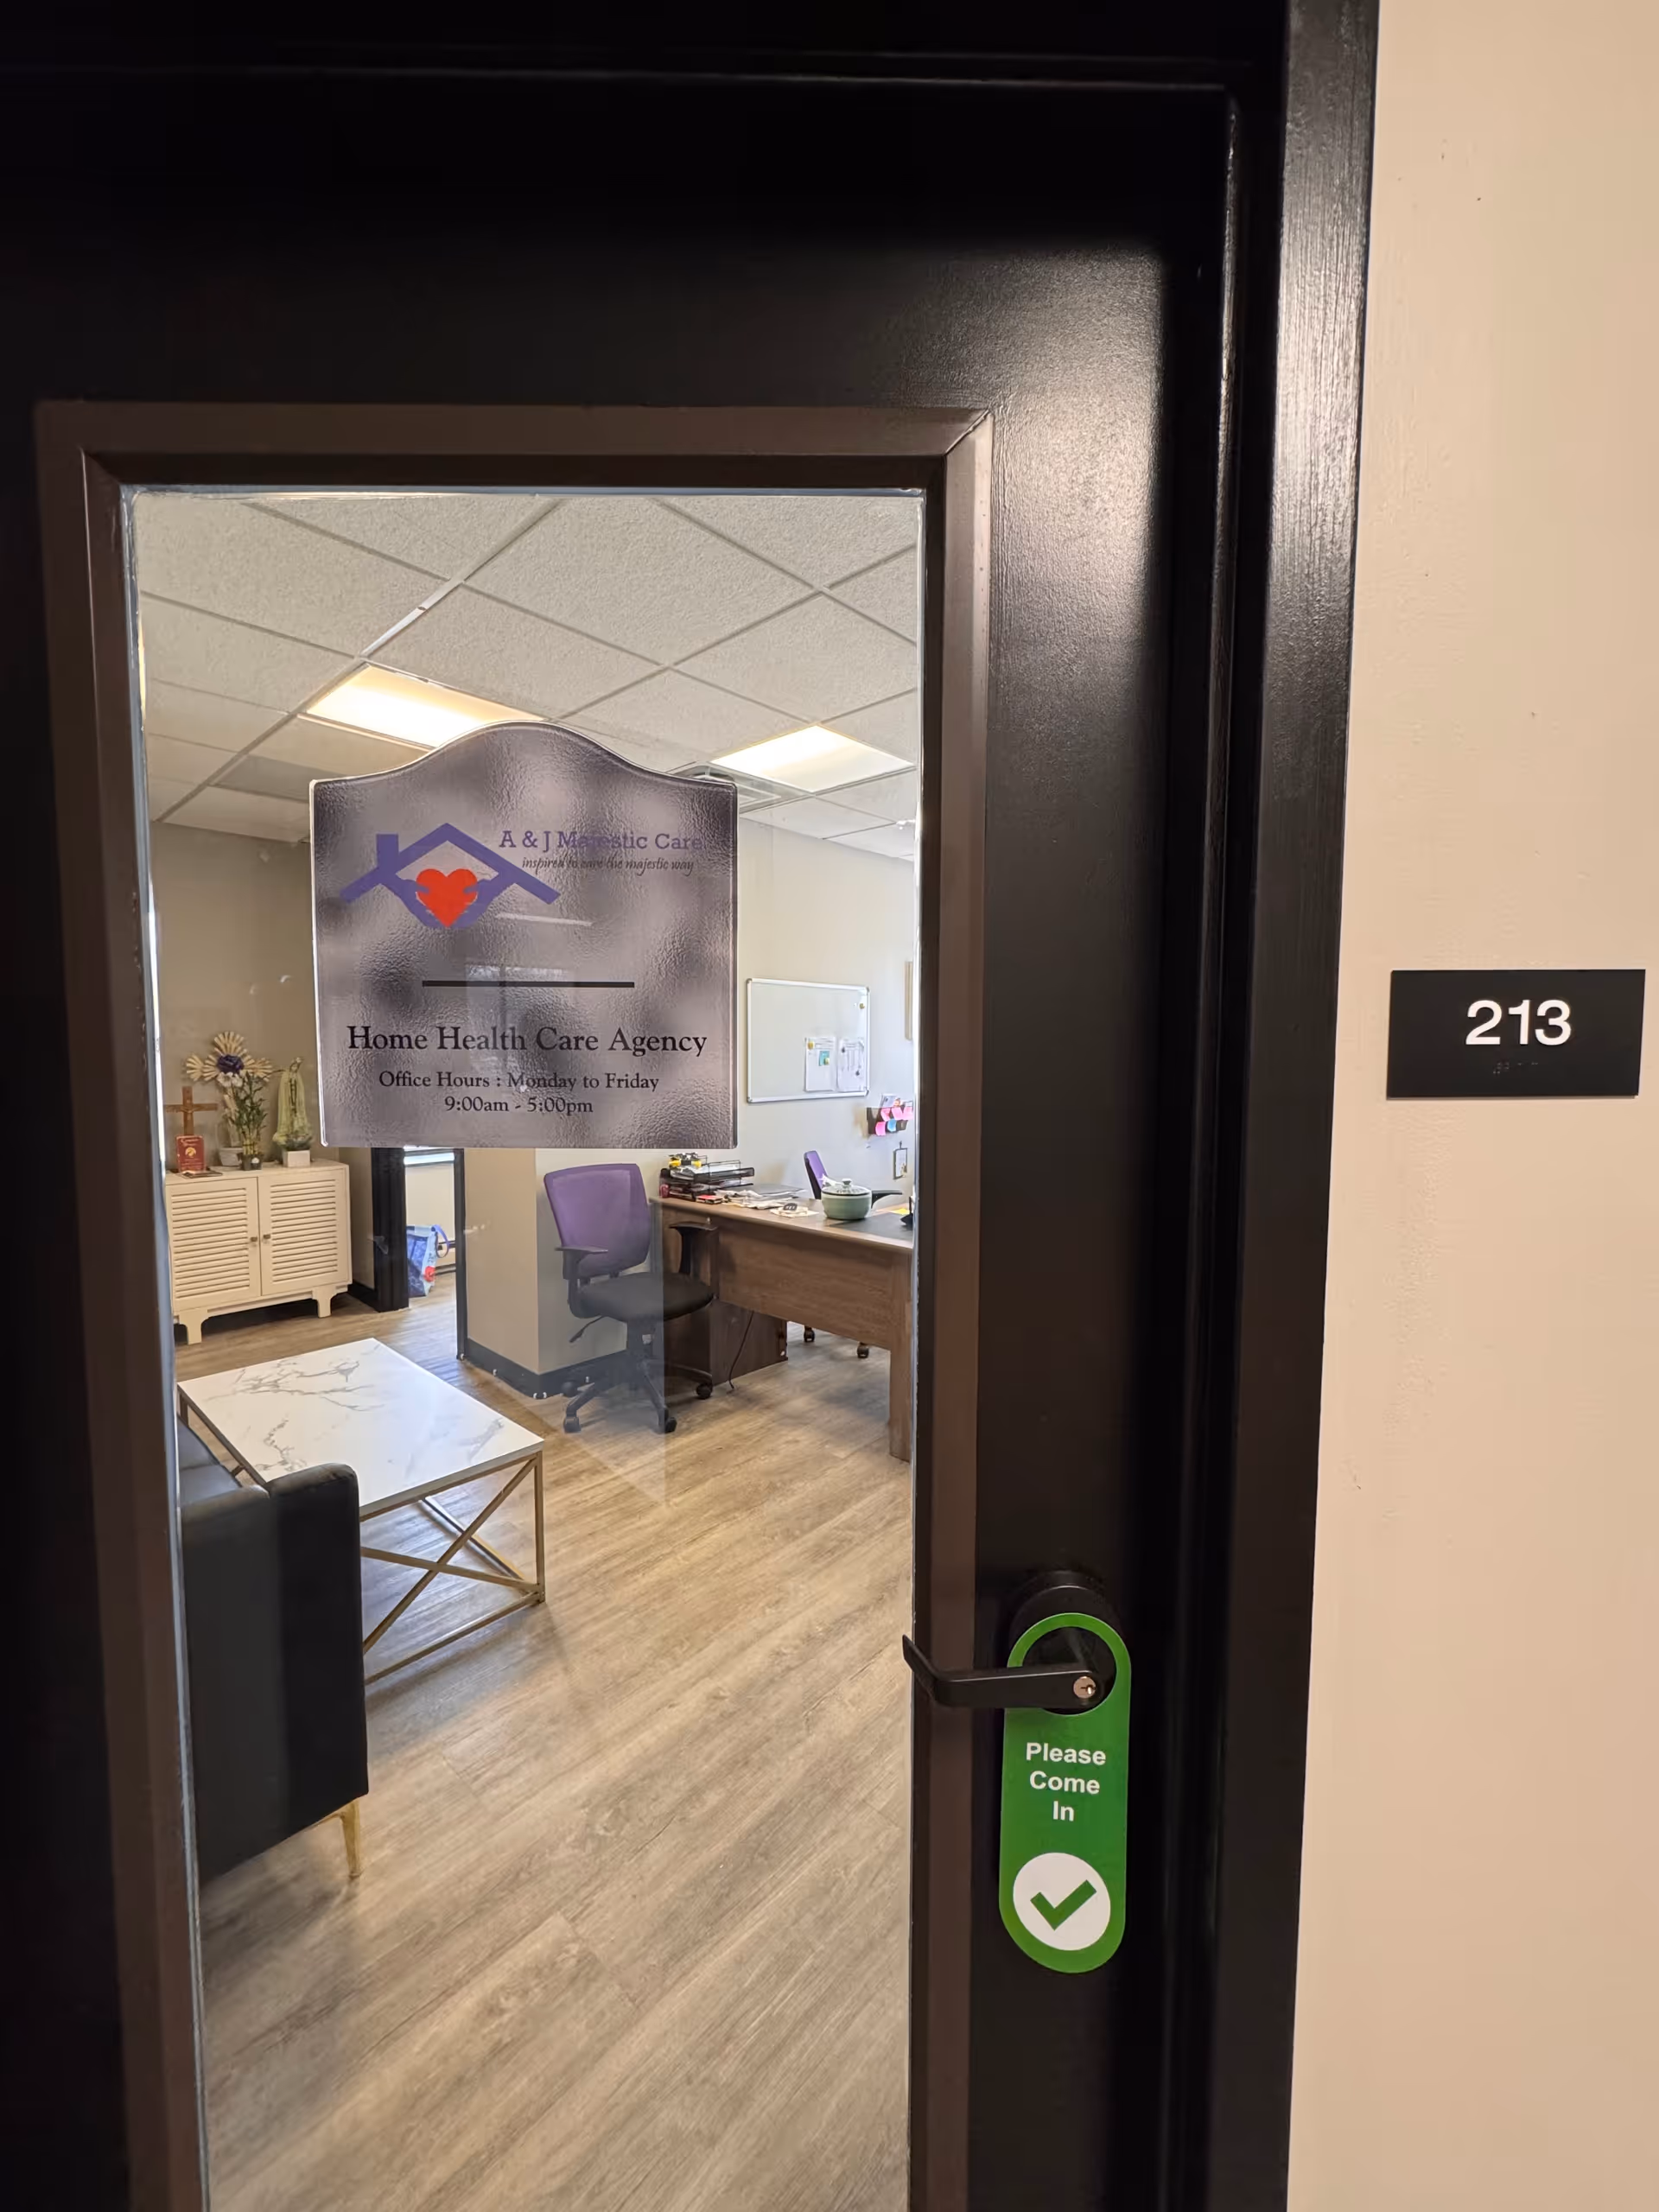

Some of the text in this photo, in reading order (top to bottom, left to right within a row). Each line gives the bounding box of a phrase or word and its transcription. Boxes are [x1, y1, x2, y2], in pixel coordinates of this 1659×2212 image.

[499, 830, 516, 849] A
[522, 830, 538, 849] &
[543, 830, 550, 853] J
[654, 833, 703, 850] Care
[625, 857, 669, 876] majestic
[671, 861, 694, 877] way
[1465, 999, 1572, 1046] 213
[346, 1025, 708, 1058] Home Health Care Agency
[378, 1070, 432, 1088] Office
[435, 1071, 490, 1088] Hours
[507, 1072, 577, 1092] Monday
[583, 1076, 600, 1089] to
[604, 1072, 659, 1092] Friday
[444, 1096, 510, 1112] 9:00am
[527, 1096, 594, 1116] 5:00pm
[1026, 1742, 1107, 1766] Please
[1029, 1770, 1101, 1795] Come
[1052, 1800, 1075, 1822] In
